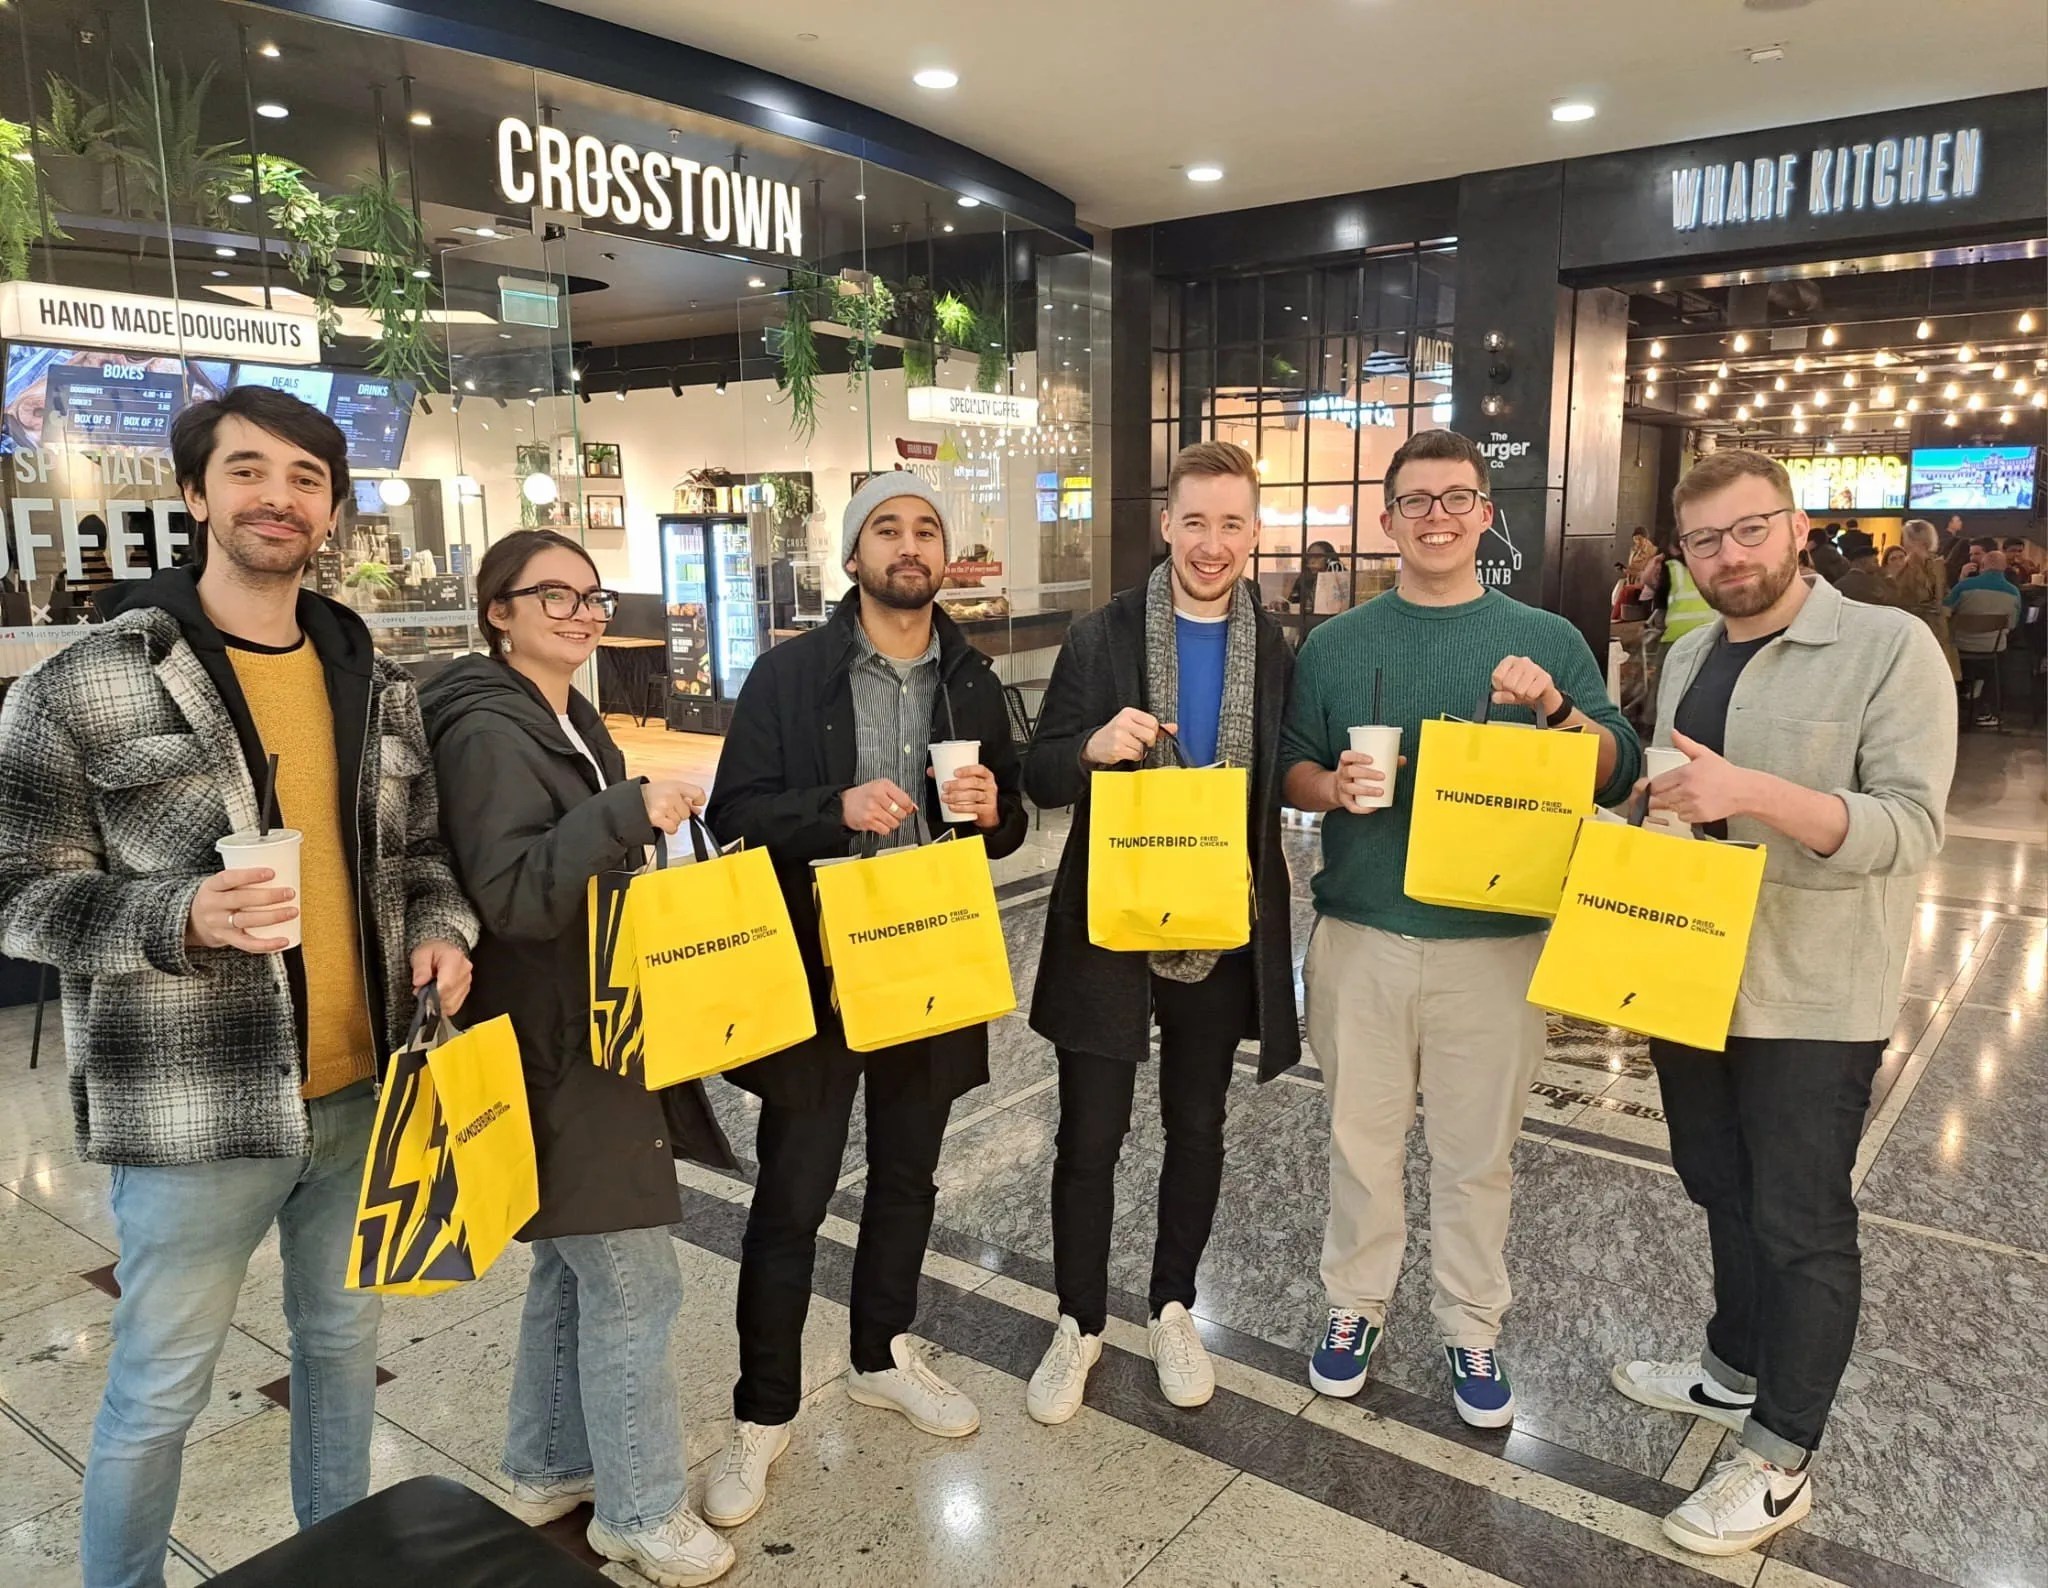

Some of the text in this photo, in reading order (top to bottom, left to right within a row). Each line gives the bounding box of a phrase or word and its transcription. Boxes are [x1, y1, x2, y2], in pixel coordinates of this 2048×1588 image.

[1672, 127, 1979, 231] WHARF KITCHEN
[498, 117, 803, 257] CROSSTOWN
[39, 298, 301, 347] HAND MADE DOUGHNUTS
[103, 364, 145, 380] BOXES
[271, 376, 299, 388] DEALS
[357, 384, 389, 397] DRINKS
[74, 413, 91, 424] BOX
[92, 414, 104, 424] OF
[123, 416, 165, 428] BOX OF 12
[1490, 432, 1508, 441] The
[14, 447, 176, 486] SPIALT
[1490, 460, 1505, 469] Co.
[0, 498, 190, 581] FFEE
[48, 631, 60, 640] try
[1435, 789, 1539, 811] THUNDERBIRD
[1541, 806, 1572, 814] CHICKEN
[1108, 836, 1198, 848] THUNDERBIRD
[950, 909, 969, 917] FRIED
[1576, 893, 1689, 928] THUNDERBIRD
[950, 912, 980, 923] CHICKEN
[1691, 918, 1715, 929] FRIED
[750, 925, 768, 935] FRIED
[752, 928, 777, 942] CHICKEN
[848, 914, 948, 944] THUNDERBIRD
[1690, 924, 1726, 937] CHICKEN
